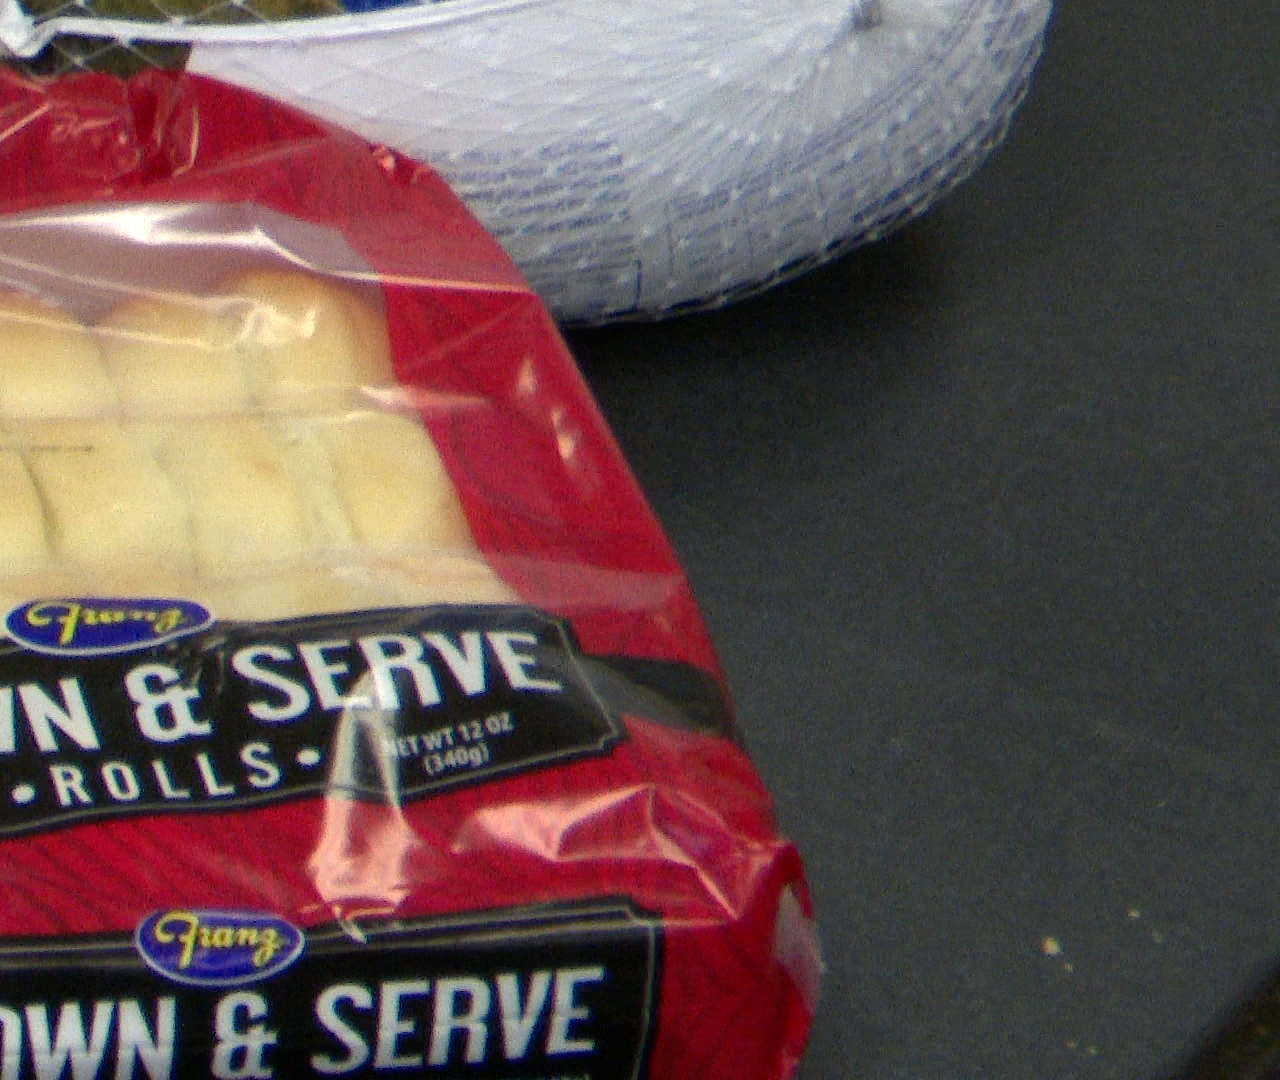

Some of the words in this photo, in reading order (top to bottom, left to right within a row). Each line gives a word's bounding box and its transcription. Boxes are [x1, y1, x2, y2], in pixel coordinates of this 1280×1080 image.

[131, 661, 211, 746] &
[233, 630, 565, 724] SERVE
[381, 734, 420, 757] NET
[420, 727, 454, 751] WT
[456, 719, 484, 742] 12
[484, 711, 515, 735] OZ
[422, 741, 491, 777] (340g)
[49, 746, 282, 807] ROLLS
[153, 911, 284, 968] Franz
[213, 991, 278, 1078] &
[313, 965, 606, 1075] SERVE
